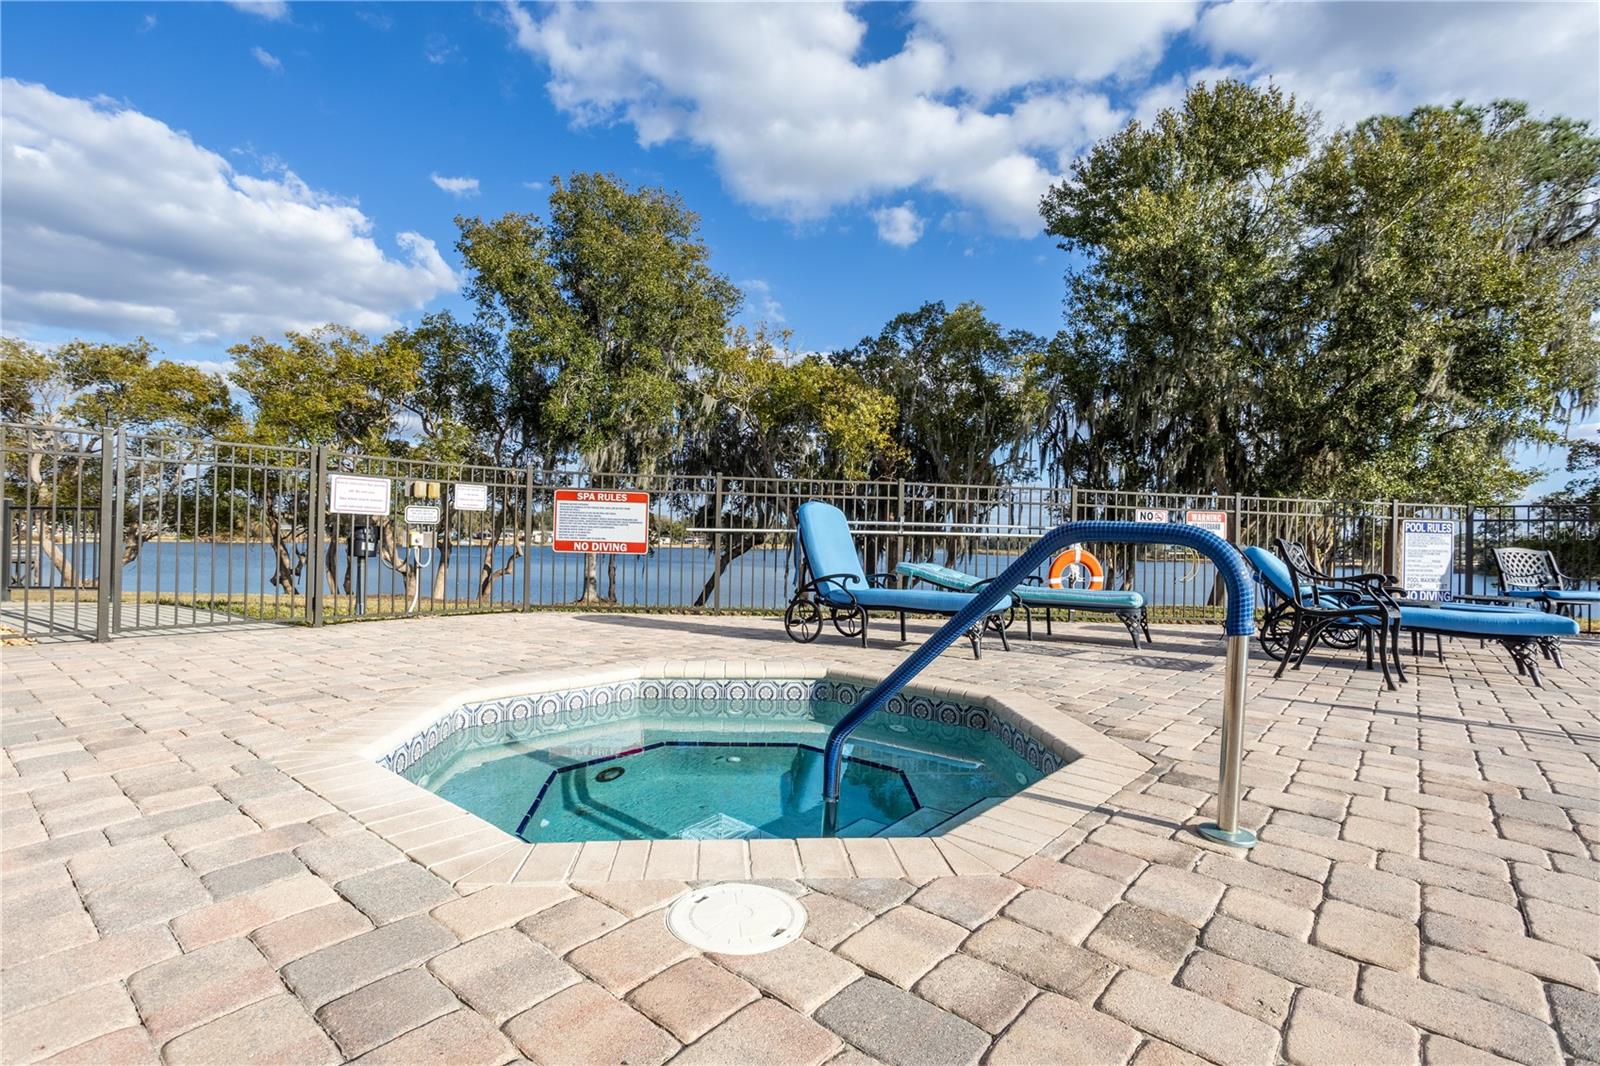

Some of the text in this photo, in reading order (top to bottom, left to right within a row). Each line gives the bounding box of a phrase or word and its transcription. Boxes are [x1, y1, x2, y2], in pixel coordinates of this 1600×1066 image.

[577, 492, 628, 501] SPA RULES
[1140, 511, 1154, 520] NO
[1191, 513, 1222, 522] WARNING
[1405, 522, 1452, 533] POOL RULES
[573, 542, 628, 552] NO DIVING
[1420, 591, 1451, 601] DIVING
